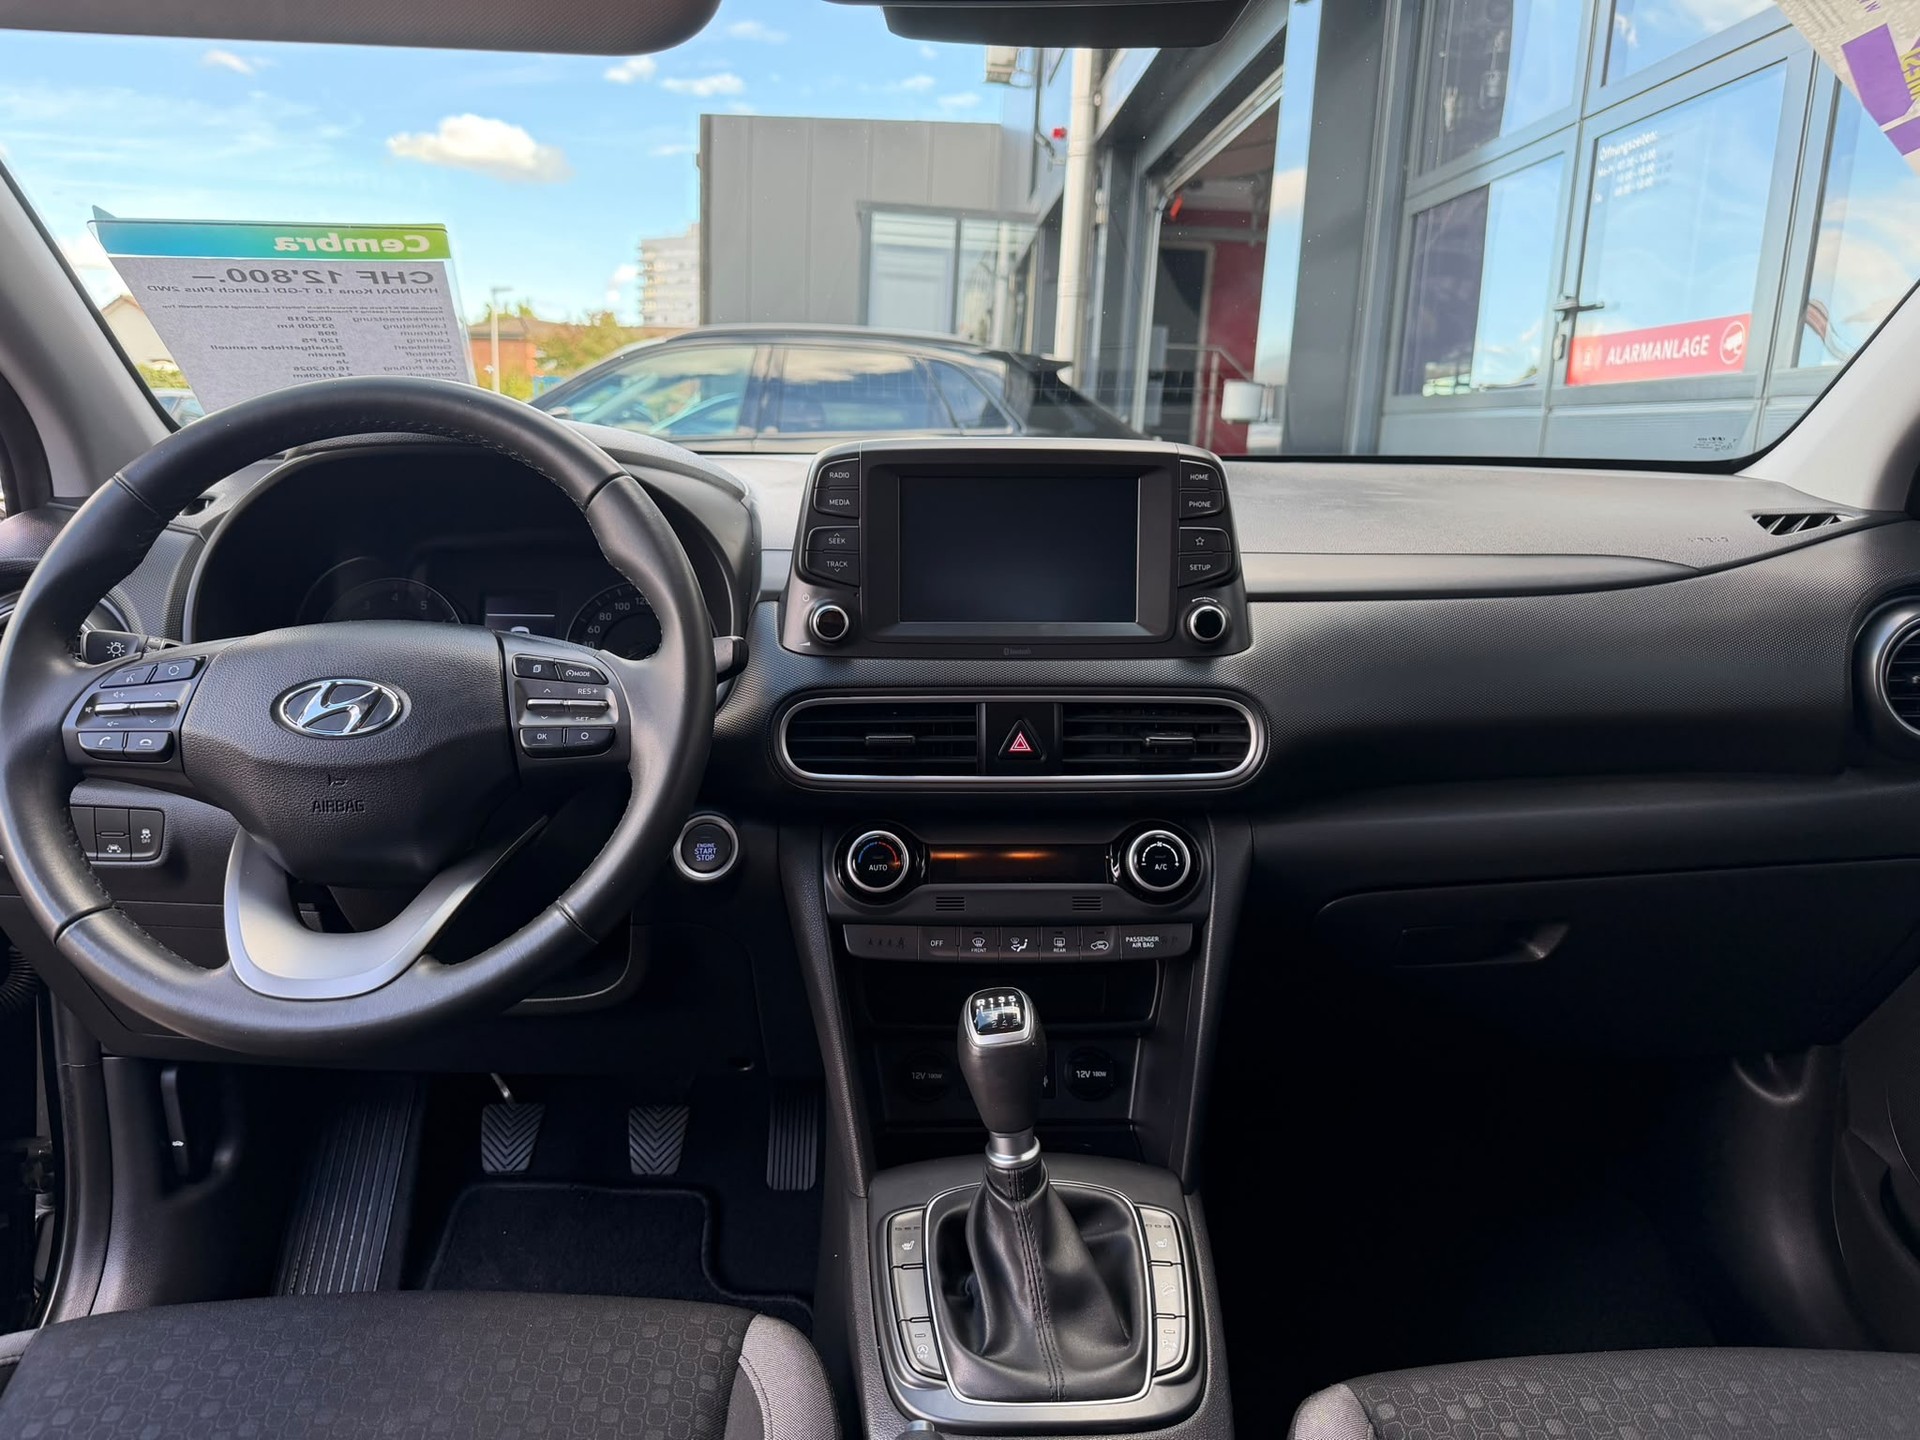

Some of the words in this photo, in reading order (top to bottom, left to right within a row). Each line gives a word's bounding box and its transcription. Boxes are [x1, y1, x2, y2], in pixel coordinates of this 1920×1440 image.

[1605, 335, 1711, 366] ALARMANLAGE
[420, 601, 427, 610] 5
[614, 602, 630, 611] 100
[599, 612, 612, 621] 80
[587, 625, 600, 634] 60
[312, 800, 365, 813] AIRBAG
[976, 998, 985, 1007] R
[912, 1071, 926, 1080] 12V
[1076, 1070, 1090, 1078] 12V
